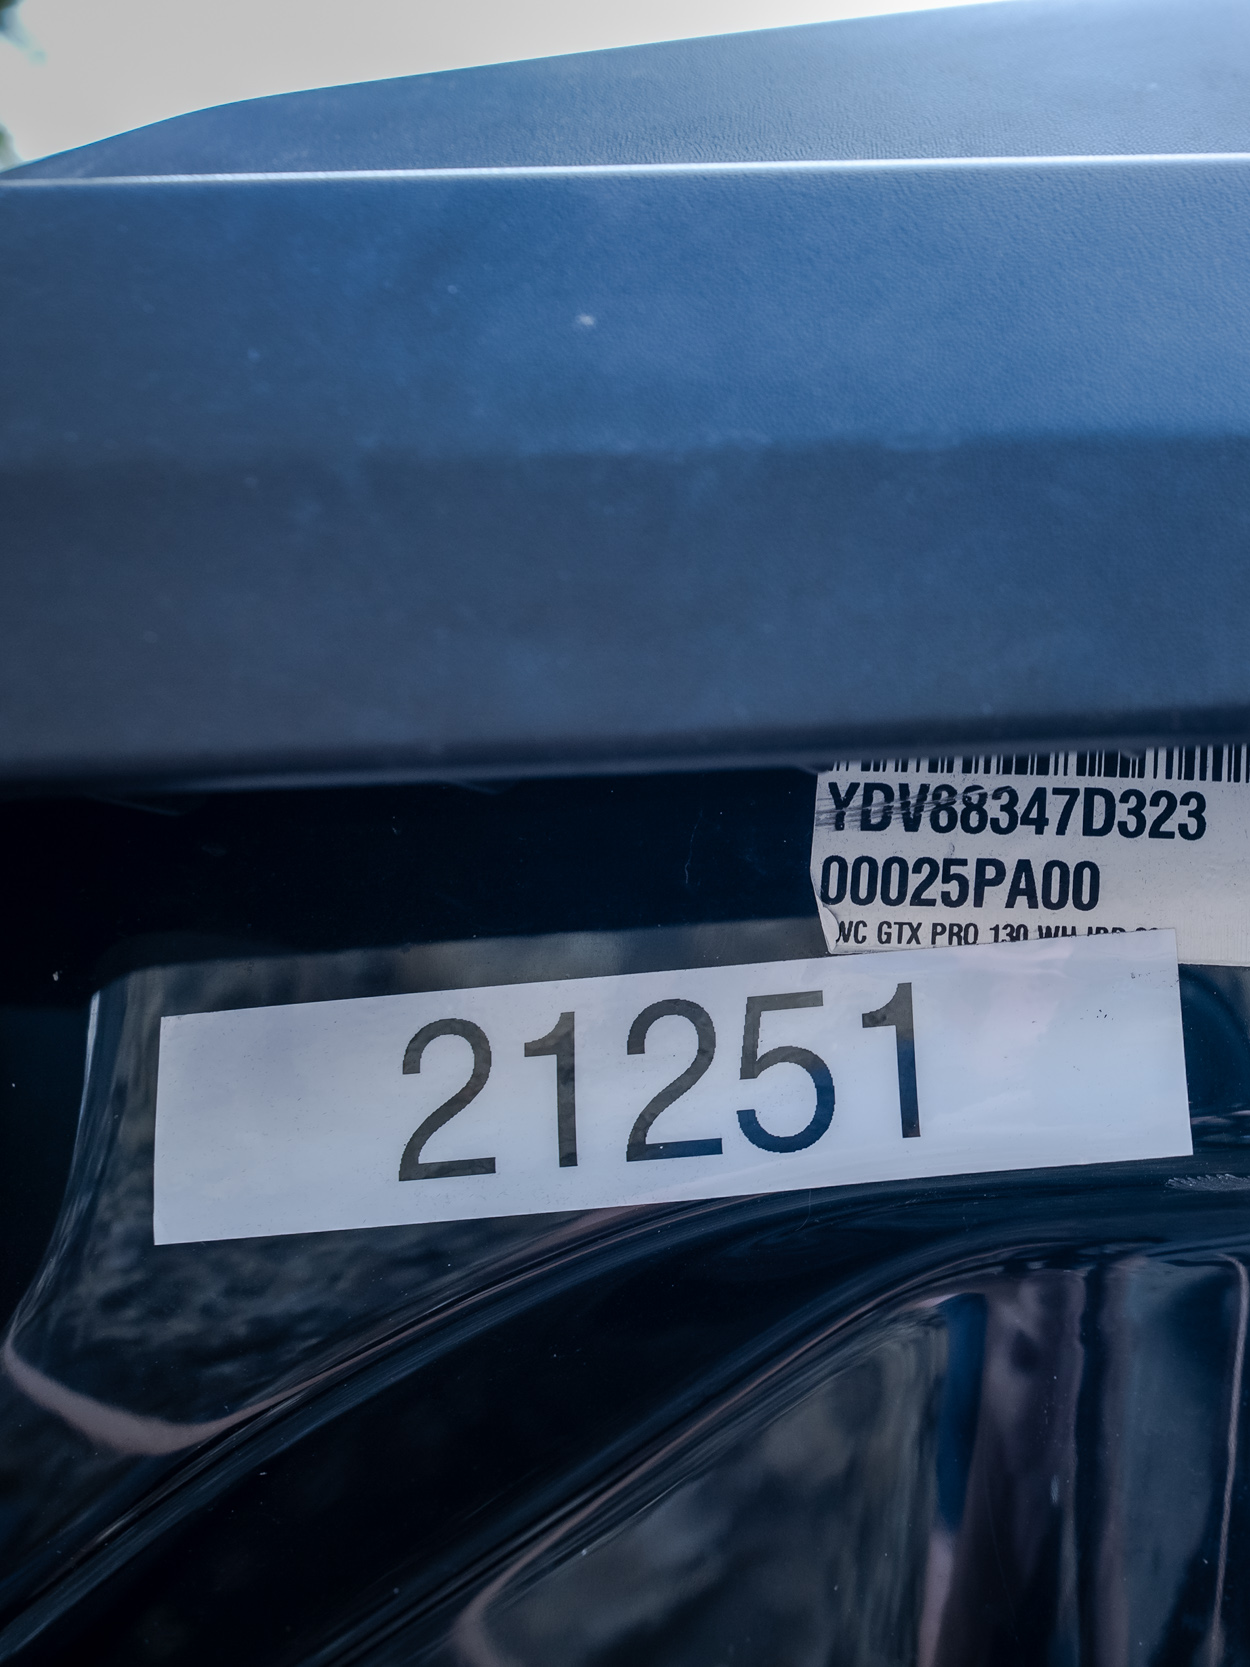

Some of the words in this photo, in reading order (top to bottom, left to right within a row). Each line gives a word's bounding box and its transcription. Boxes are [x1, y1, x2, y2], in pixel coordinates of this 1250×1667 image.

[828, 782, 1207, 840] YDV88347D323
[820, 855, 1100, 911] 00025PA00
[877, 921, 922, 945] GTX
[931, 922, 979, 945] PRO
[989, 924, 1028, 942] 130
[398, 982, 921, 1182] 21251
